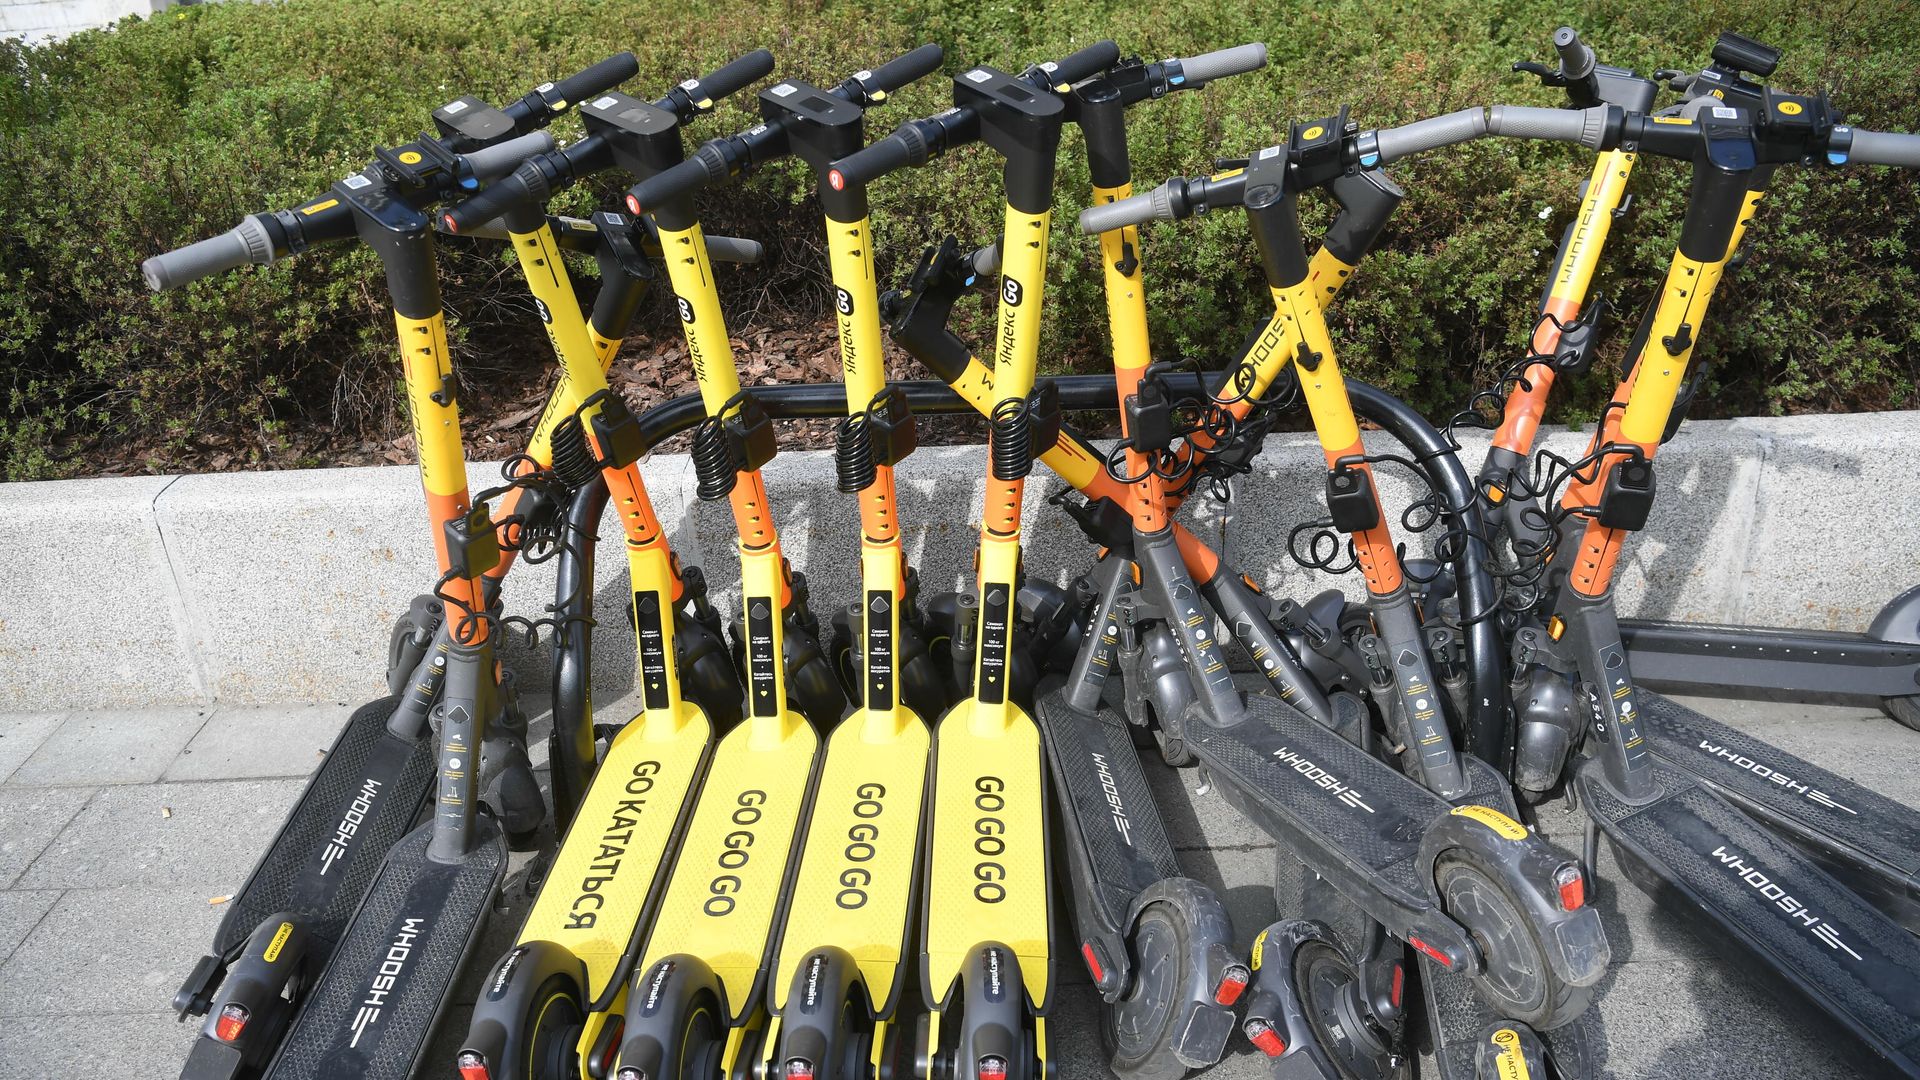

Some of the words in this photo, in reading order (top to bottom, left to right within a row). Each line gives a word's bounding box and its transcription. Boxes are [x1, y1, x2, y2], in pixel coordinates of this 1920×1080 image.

[686, 326, 708, 382] Яндекс
[841, 318, 857, 375] Яндекс
[1000, 308, 1016, 366] Яндекс
[625, 760, 661, 795] GO
[1092, 753, 1126, 817] WHOOSH
[1273, 746, 1353, 801] WHOOSH
[1699, 740, 1808, 794] WHOOSH
[332, 778, 382, 847] WHOOSH
[732, 789, 767, 826] GO
[853, 782, 887, 818] GO
[975, 776, 1005, 812] GO
[718, 830, 755, 870] GO
[845, 823, 879, 863] GO
[974, 817, 1006, 856] GO
[563, 800, 647, 930] КАТАТЬСЯ
[973, 861, 1006, 904] GO
[703, 875, 742, 917] GO
[835, 868, 872, 910] GO
[1712, 846, 1820, 928] WHOOSH
[364, 918, 424, 1006] WHOOSH
[990, 956, 1000, 995] наступайте
[646, 970, 666, 1009] наступайте
[807, 965, 819, 1006] наступайте
